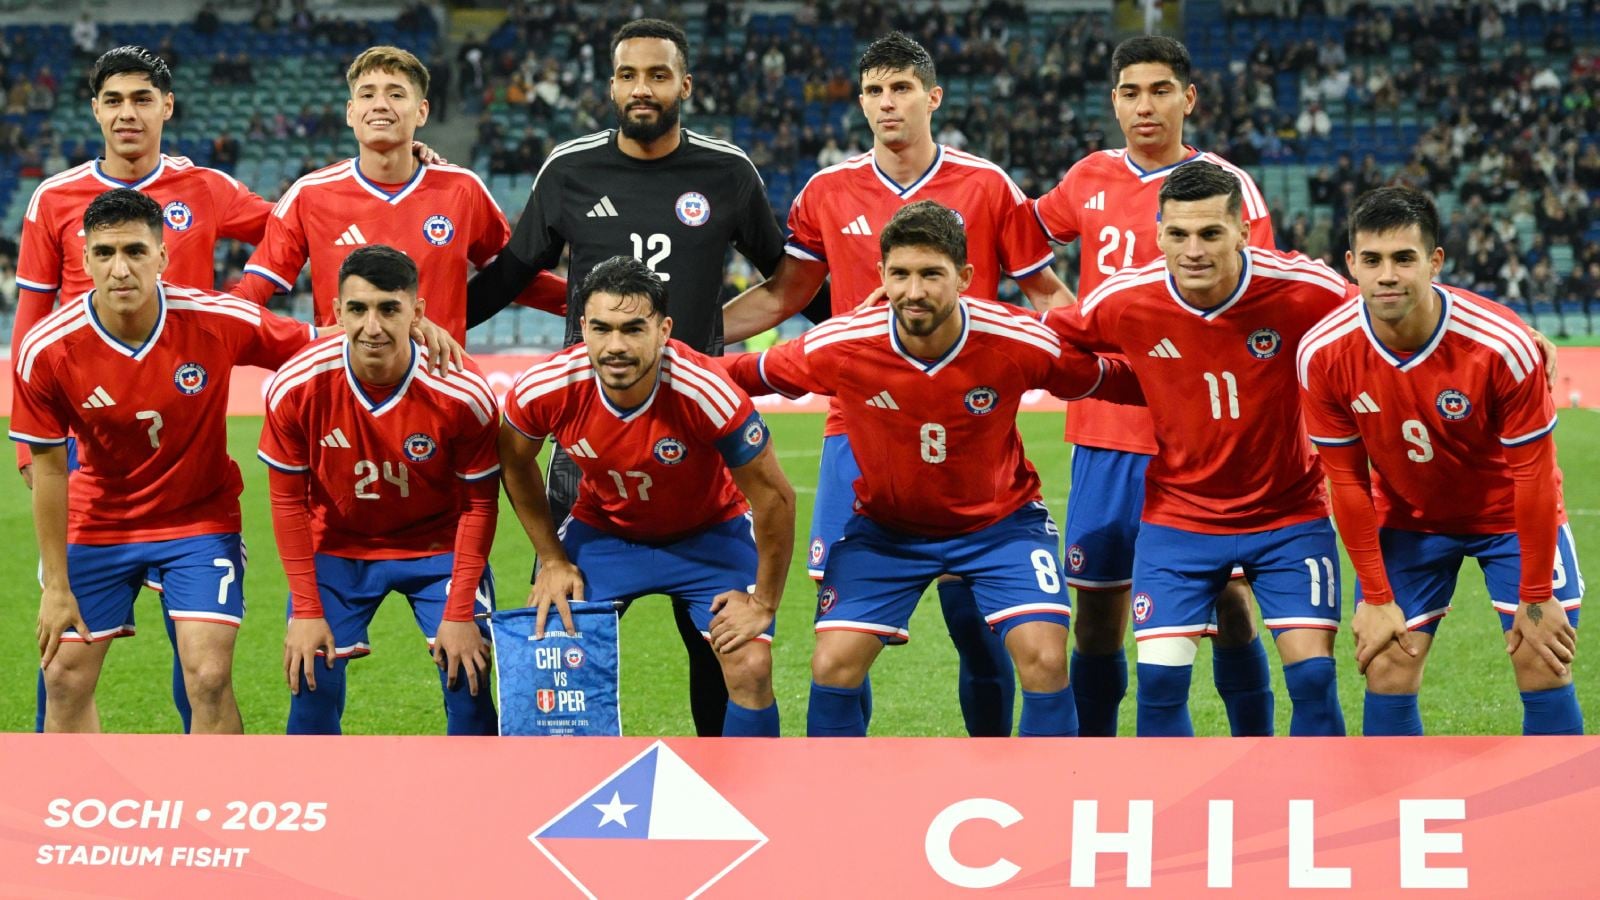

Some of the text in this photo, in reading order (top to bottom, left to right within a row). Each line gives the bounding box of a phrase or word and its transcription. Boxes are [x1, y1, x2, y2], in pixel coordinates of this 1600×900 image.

[630, 233, 671, 281] 12
[1097, 225, 1136, 276] 21
[1204, 372, 1240, 420] 11
[135, 411, 163, 448] 7
[920, 423, 946, 464] 8
[1402, 419, 1434, 463] 9
[354, 460, 410, 500] 24
[608, 470, 653, 501] 17
[213, 558, 235, 605] 7
[1030, 548, 1060, 594] 8
[1304, 556, 1336, 608] 11
[535, 647, 561, 669] CHI
[554, 671, 568, 687] VS
[558, 690, 586, 712] PER
[44, 798, 328, 832] SOCHI 2025
[36, 844, 251, 869] STADIUM FISHT
[925, 797, 1469, 889] CHILE
